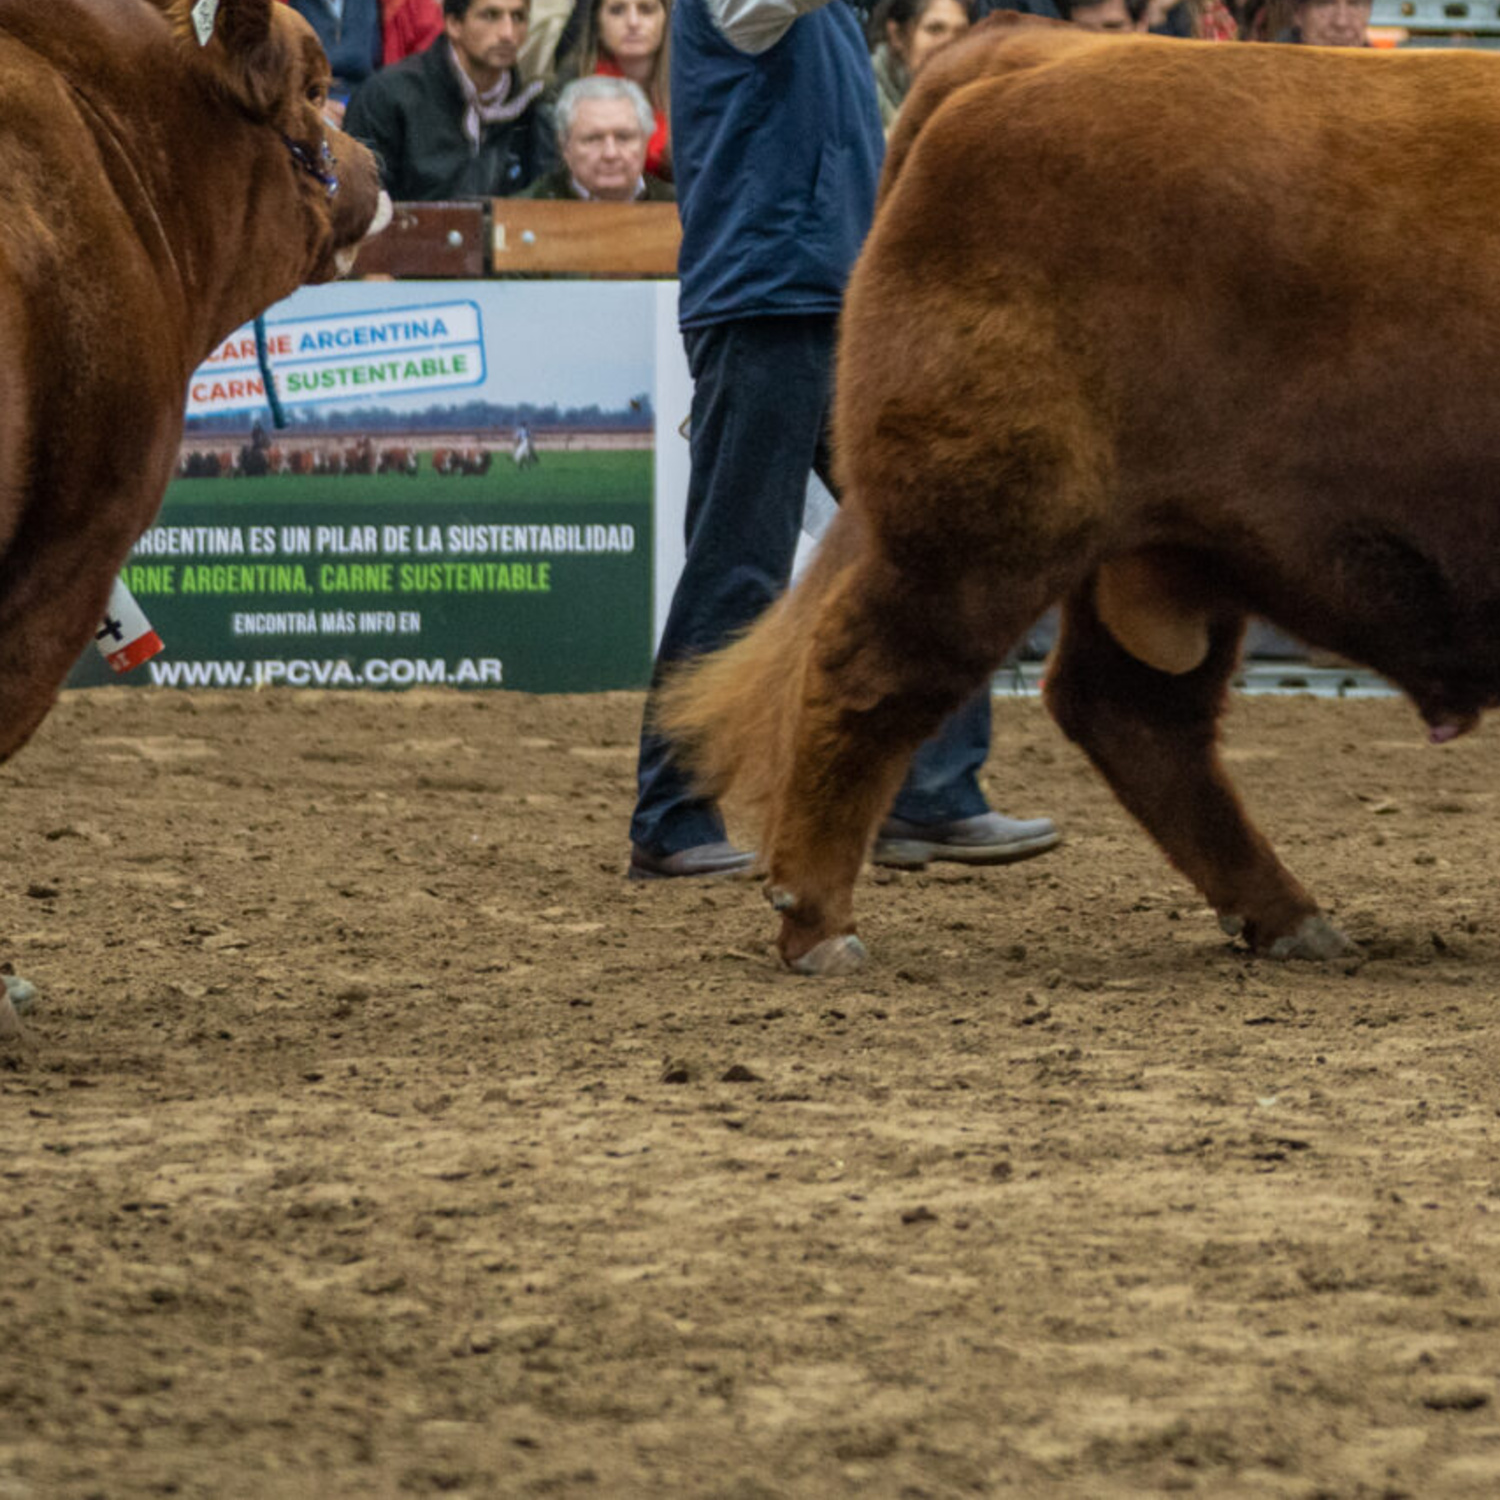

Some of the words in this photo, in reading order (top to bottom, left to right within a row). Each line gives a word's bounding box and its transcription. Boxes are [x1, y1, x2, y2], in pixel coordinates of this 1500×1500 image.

[300, 318, 448, 351] ARGENTINA
[192, 375, 280, 403] CARN
[286, 354, 468, 392] SUSTENTABLE
[250, 526, 276, 553] ES
[282, 526, 310, 553] UN
[316, 525, 378, 553] PILAR
[383, 525, 411, 553] DE
[416, 525, 443, 552] LA
[449, 524, 635, 552] SUSTENTABILIDAD
[181, 565, 314, 594] ARGENTINA,
[320, 564, 393, 592] CARNE
[401, 563, 551, 592] SUSTENTABLE
[321, 608, 355, 633] MÁS
[360, 611, 395, 633] INFO
[401, 611, 421, 633] EN
